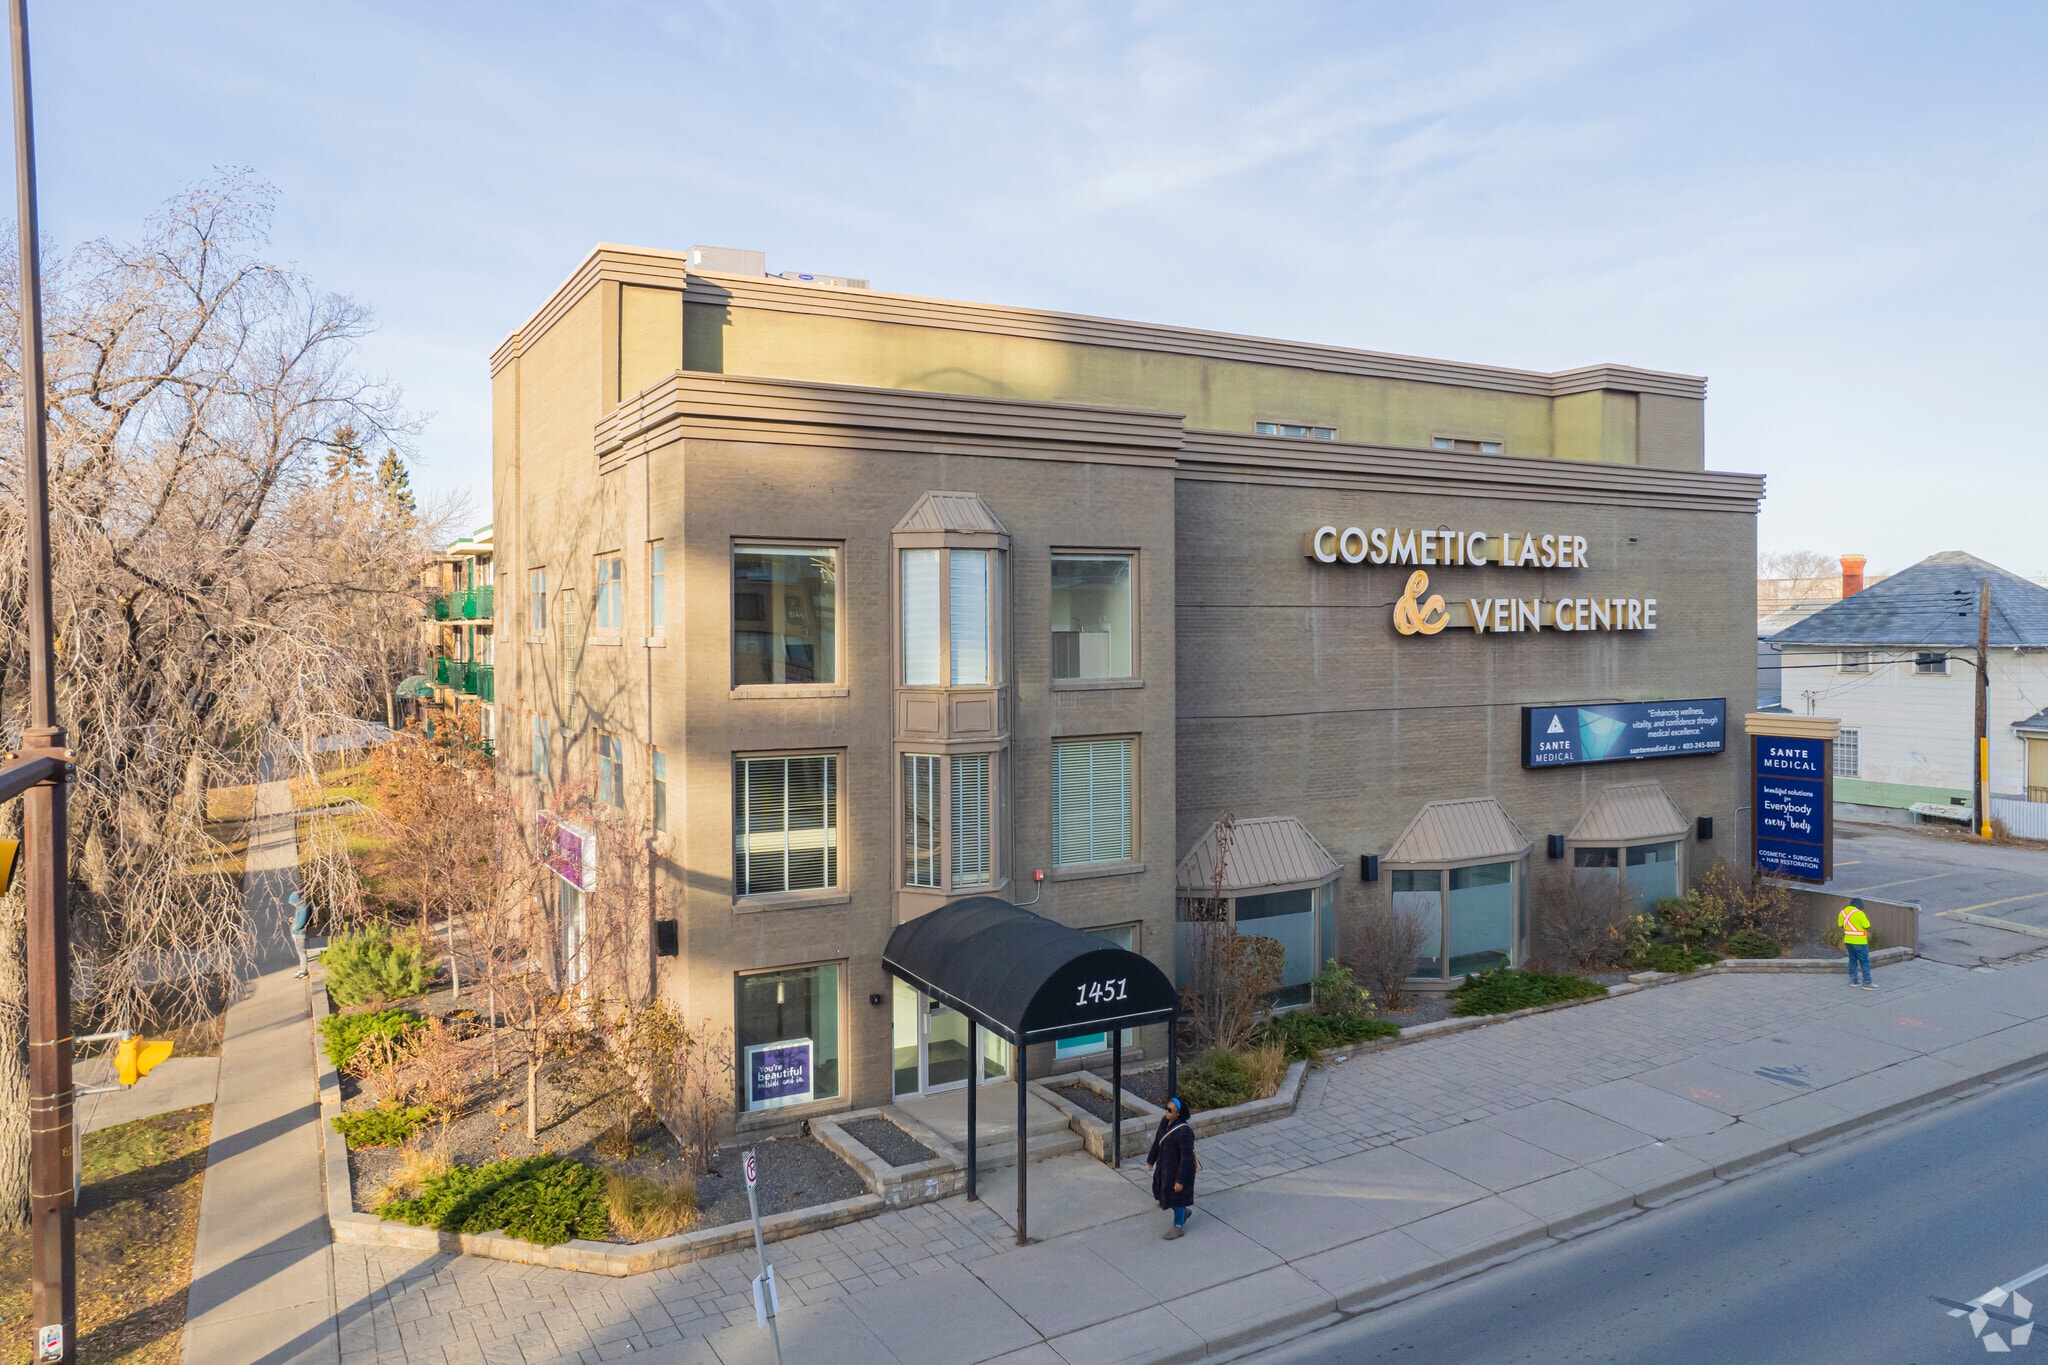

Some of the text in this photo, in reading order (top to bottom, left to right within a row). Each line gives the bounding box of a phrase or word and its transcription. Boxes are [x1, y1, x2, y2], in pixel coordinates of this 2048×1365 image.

[1312, 525, 1589, 568] COSMETIC LASER
[1393, 569, 1657, 636] & VEIN CENTRE
[1653, 719, 1664, 727] and
[1666, 717, 1696, 726] confidence
[1697, 716, 1718, 725] through
[1648, 729, 1670, 738] medical
[1539, 740, 1571, 751] SANTE
[1535, 752, 1574, 762] MEDICAL
[1769, 747, 1809, 758] SANTE
[1763, 759, 1817, 771] MEDICAL
[1788, 789, 1814, 797] solutions
[1764, 800, 1812, 816] Everybody
[1764, 816, 1812, 833] every body
[1759, 849, 1787, 858] COSMETIC
[1792, 854, 1820, 863] SURGICAL
[1780, 858, 1819, 869] RESTORATION
[1076, 978, 1128, 1006] 1451
[758, 1066, 802, 1081] beautiful
[759, 1064, 783, 1072] You're
